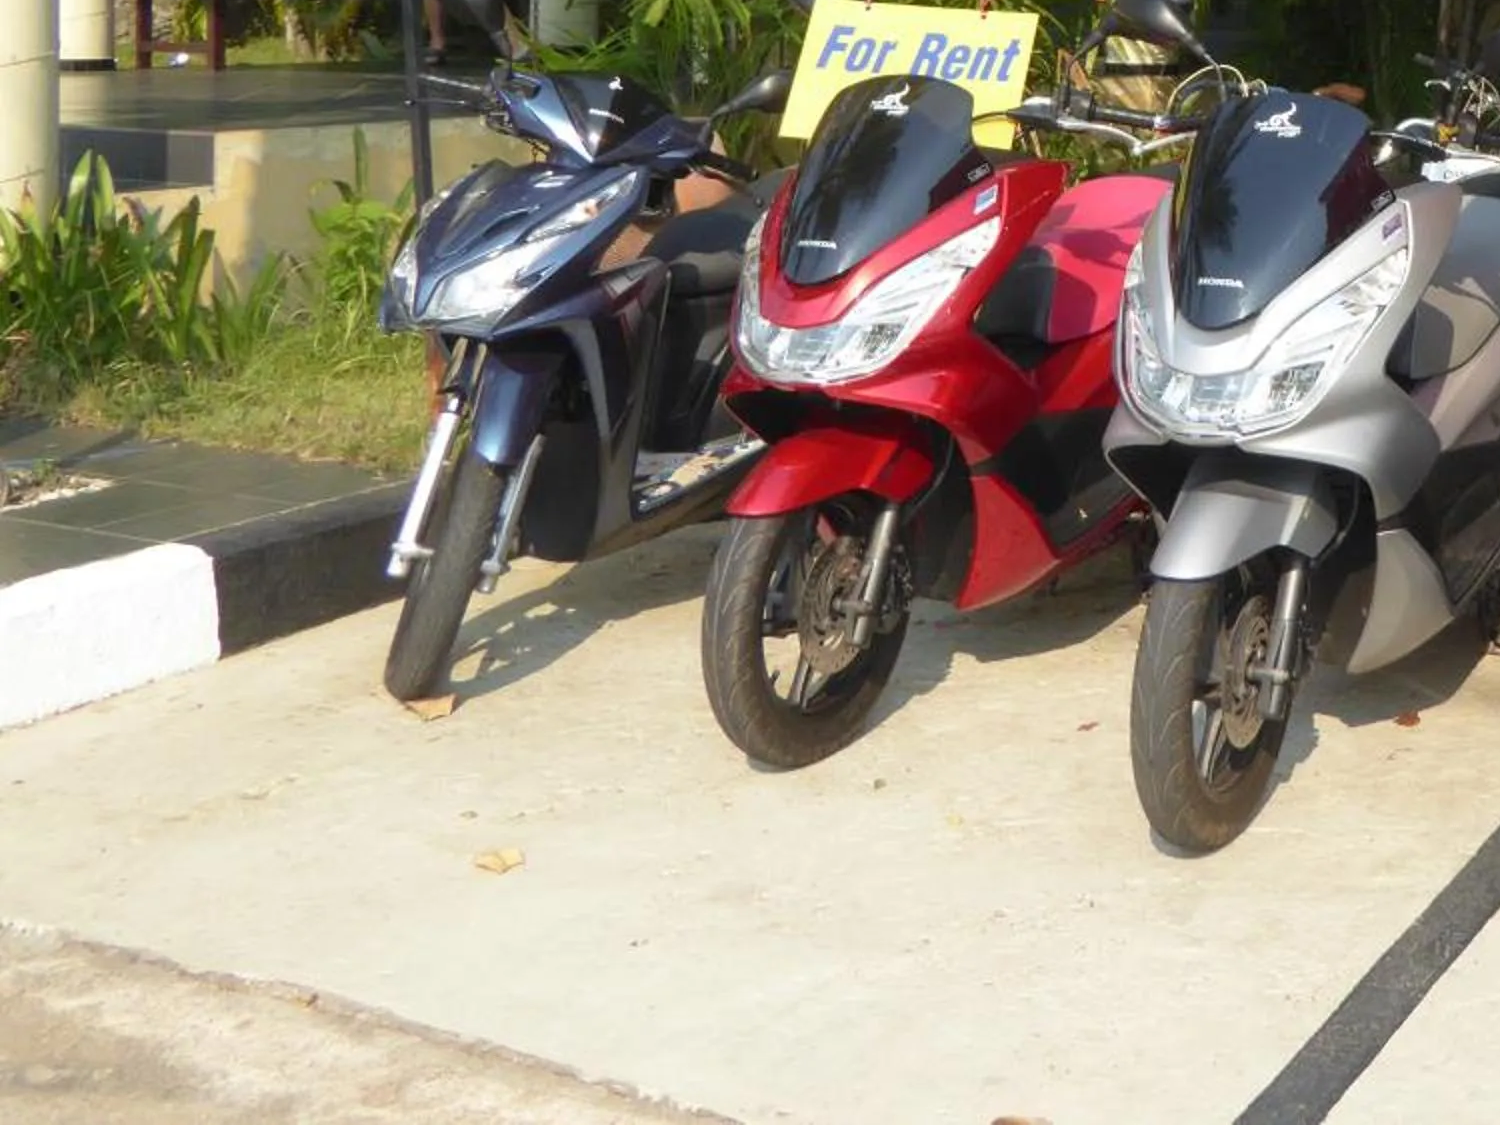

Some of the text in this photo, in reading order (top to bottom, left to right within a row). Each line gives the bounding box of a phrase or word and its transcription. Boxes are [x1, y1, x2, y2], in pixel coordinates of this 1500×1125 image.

[816, 24, 1021, 82] For Rent
[1198, 277, 1244, 289] HONDA
